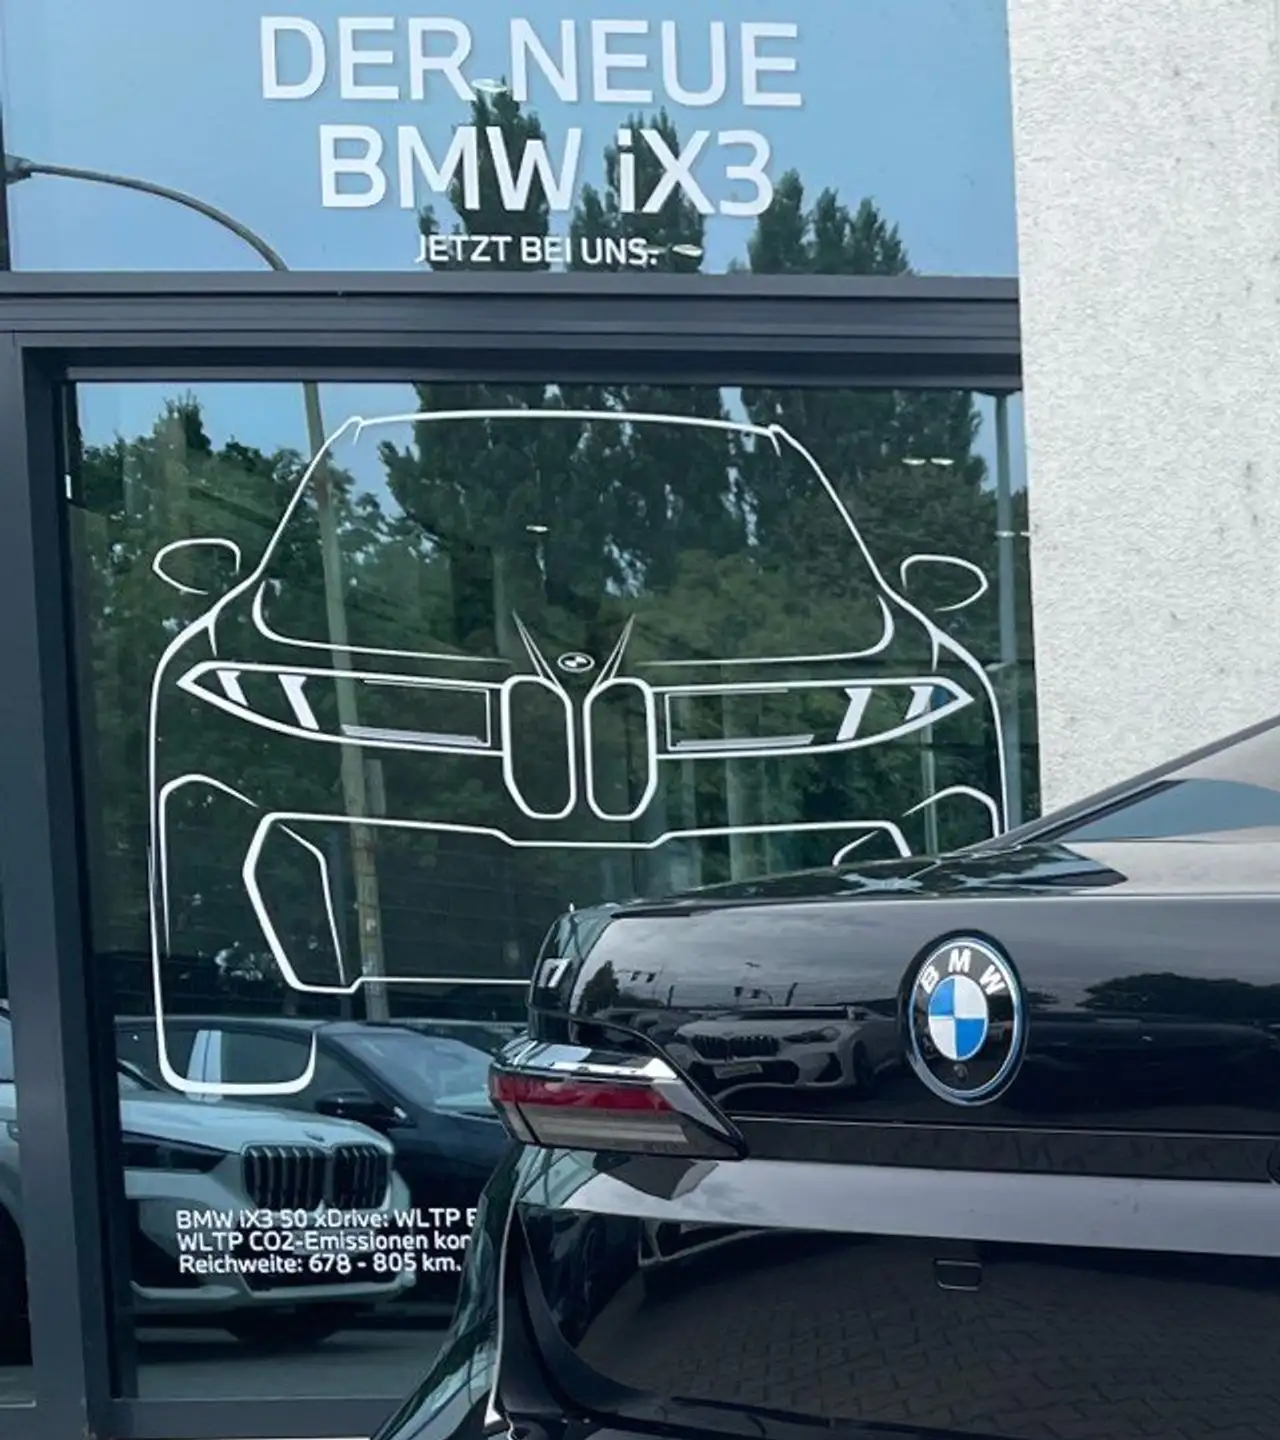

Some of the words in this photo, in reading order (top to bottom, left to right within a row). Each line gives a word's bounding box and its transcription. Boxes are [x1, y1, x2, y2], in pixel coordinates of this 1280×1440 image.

[260, 16, 473, 101] DER
[511, 18, 802, 107] NEUE
[319, 125, 581, 212] BMW
[617, 128, 774, 217] iX3
[415, 234, 512, 262] JETZT
[520, 236, 571, 263] BEI
[581, 237, 657, 265] UNS.
[919, 948, 1006, 995] BMW
[176, 1208, 233, 1229] BMW
[280, 1208, 307, 1228] 50
[314, 1208, 388, 1228] xDrive:
[393, 1207, 461, 1228] WLTP
[176, 1231, 243, 1251] WLTP
[249, 1230, 429, 1251] CO2-Emissionen
[179, 1253, 303, 1273] Reichweite:
[308, 1252, 352, 1275] 678
[373, 1252, 417, 1272] 805
[422, 1252, 462, 1271] km.
